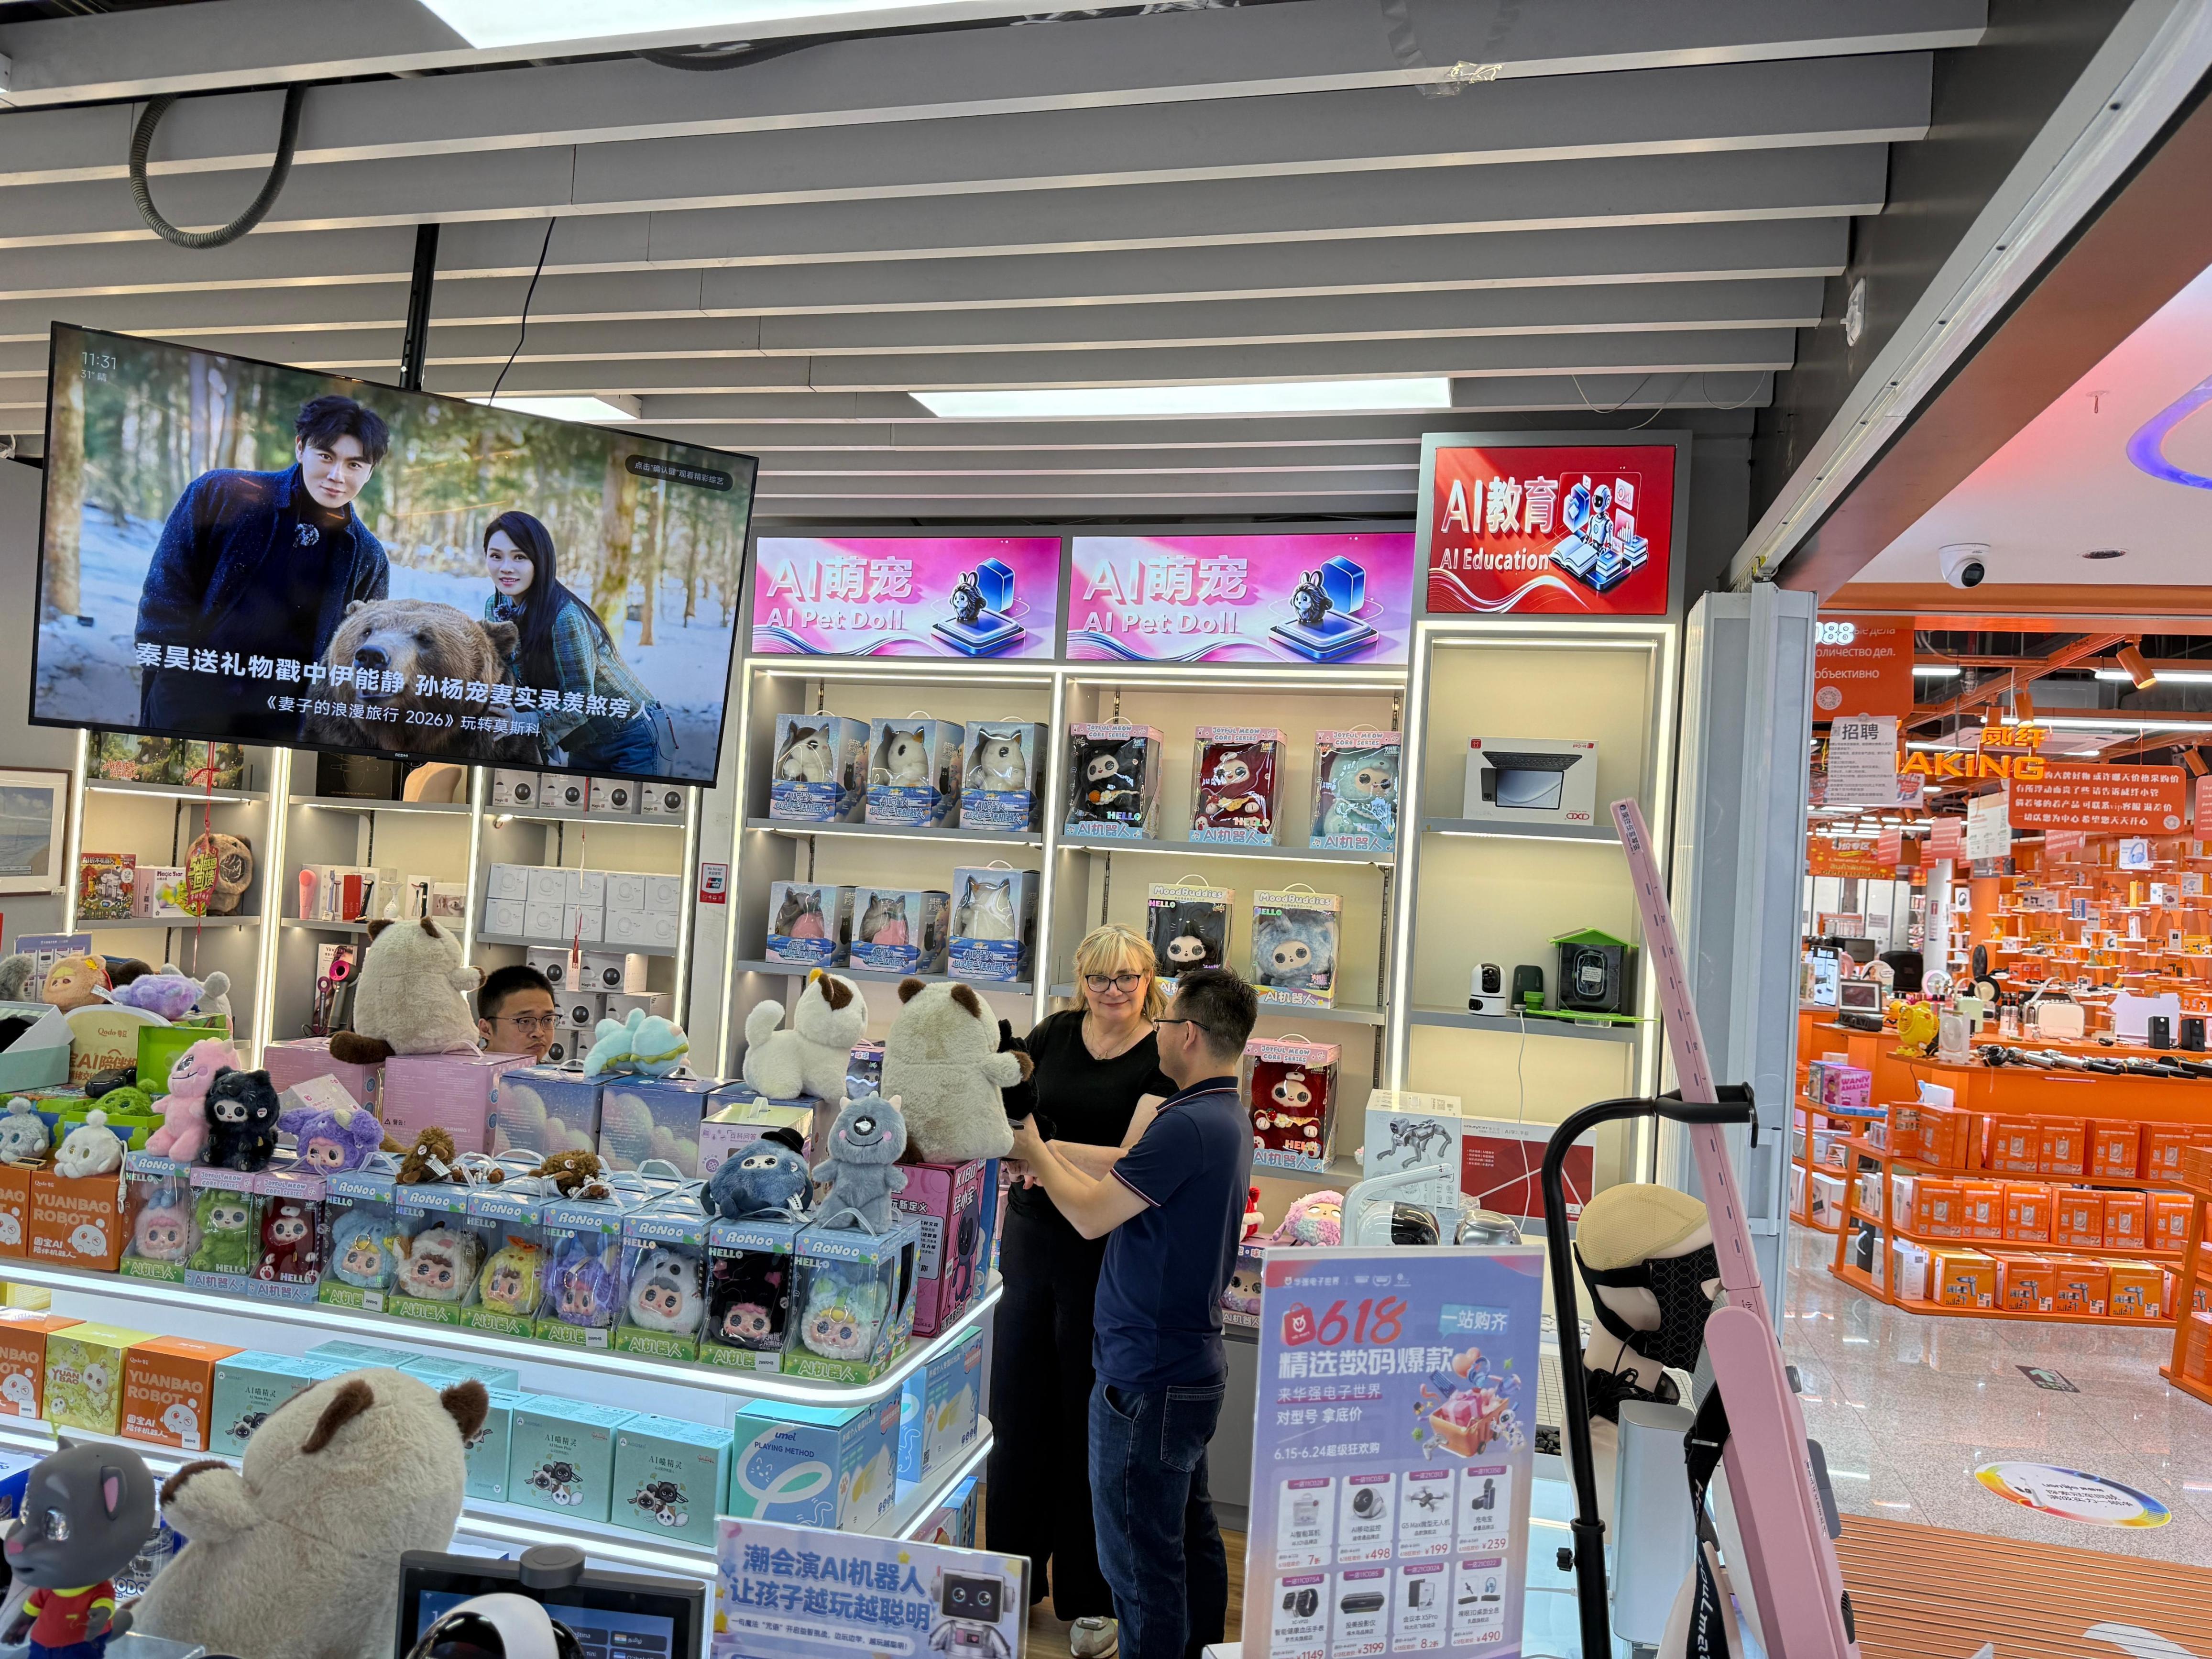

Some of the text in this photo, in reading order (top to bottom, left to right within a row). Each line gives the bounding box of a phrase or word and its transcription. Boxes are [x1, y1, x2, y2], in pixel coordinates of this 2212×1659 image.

[82, 351, 117, 370] 11:31
[1441, 476, 1558, 534] AI教育
[1440, 548, 1549, 571] AI Education
[767, 555, 914, 601] AI萌宠
[1084, 556, 1249, 602] AI萌宠
[767, 608, 904, 630] AI Pet Doll
[1084, 612, 1237, 635] AI Pet Doll
[1816, 648, 1896, 658] оличество дел.
[136, 642, 652, 721] 秦昊送礼物戳中伊能静 孙杨宠妻实录羡煞旁人
[460, 715, 541, 737] 玩转莫斯科
[1842, 723, 1879, 740] 招聘
[1107, 812, 1141, 821] HELLO
[1234, 817, 1270, 826] HELLO
[2082, 815, 2148, 825] 希望您天天开心
[1078, 824, 1129, 837] AI机器人
[1204, 829, 1258, 844] AI机器人
[1325, 836, 1381, 850] AI机器人
[1154, 886, 1223, 898] MoodBuddies
[1259, 892, 1330, 905] MoodBuddies
[1149, 900, 1175, 908] HELLO
[1264, 991, 1315, 1005] AI机器人
[98, 1028, 116, 1036] Qodo
[730, 1133, 757, 1141] 百科问答
[1253, 1152, 1310, 1170] AI机器人
[126, 1173, 155, 1182] HELLO
[200, 1172, 242, 1182] JOYFUL MEOW
[956, 1164, 976, 1188] KIBO
[201, 1179, 239, 1189] CORE SERIES
[264, 1180, 307, 1191] JOYFUL MEOW
[34, 1194, 111, 1213] YUANBAO
[326, 1196, 353, 1207] HELLO
[34, 1208, 91, 1225] ROBOT
[396, 1206, 424, 1217] HELLO
[468, 1217, 495, 1228] HELLO
[543, 1227, 575, 1238] HELLO
[34, 1236, 63, 1249] 圆宝AI
[624, 1237, 656, 1249] HELLO
[33, 1246, 77, 1259] 陪伴机器人
[709, 1248, 743, 1259] HELLO
[216, 1263, 247, 1274] HELLO
[795, 1256, 830, 1269] HELLO
[130, 1263, 174, 1279] AI机器人
[194, 1274, 239, 1290] AI机器人
[256, 1285, 303, 1300] AI机器人
[401, 1303, 448, 1321] AI机器人
[472, 1314, 519, 1333] AI机器人
[1223, 1314, 1259, 1326] AI机器人
[1317, 1295, 1408, 1346] 618
[1441, 1311, 1508, 1332] 一站购齐
[629, 1338, 681, 1358] AI机器人
[1278, 1346, 1454, 1379] 精选数码爆款
[52, 1369, 79, 1379] YUAN
[799, 1359, 855, 1381] AI机器人
[60, 1376, 79, 1385] BAO
[129, 1369, 203, 1393] YUANBAO
[128, 1385, 183, 1404] ROBOT
[245, 1387, 276, 1397] AI喵精灵
[1278, 1383, 1381, 1402] 来华强电子世界
[127, 1415, 155, 1427] 圆宝AI
[1277, 1406, 1362, 1425] 对型号 拿底价
[126, 1424, 168, 1437] 陪伴机器人
[775, 1431, 796, 1441] umei
[545, 1434, 577, 1447] AI喵精灵
[755, 1442, 814, 1458] PLAYING METHOD
[1274, 1442, 1380, 1460] 6.15-6.24超级狂欢购
[648, 1456, 682, 1470] AI喵精灵
[1424, 1544, 1448, 1555] ¥199
[1482, 1538, 1506, 1550] ¥239
[1365, 1548, 1391, 1560] ¥498
[743, 1544, 926, 1596] 潮会演AI机器人
[731, 1577, 931, 1631] 让孩子越玩越聪明
[1477, 1630, 1500, 1642] ¥490
[1358, 1642, 1384, 1655] ¥3199
